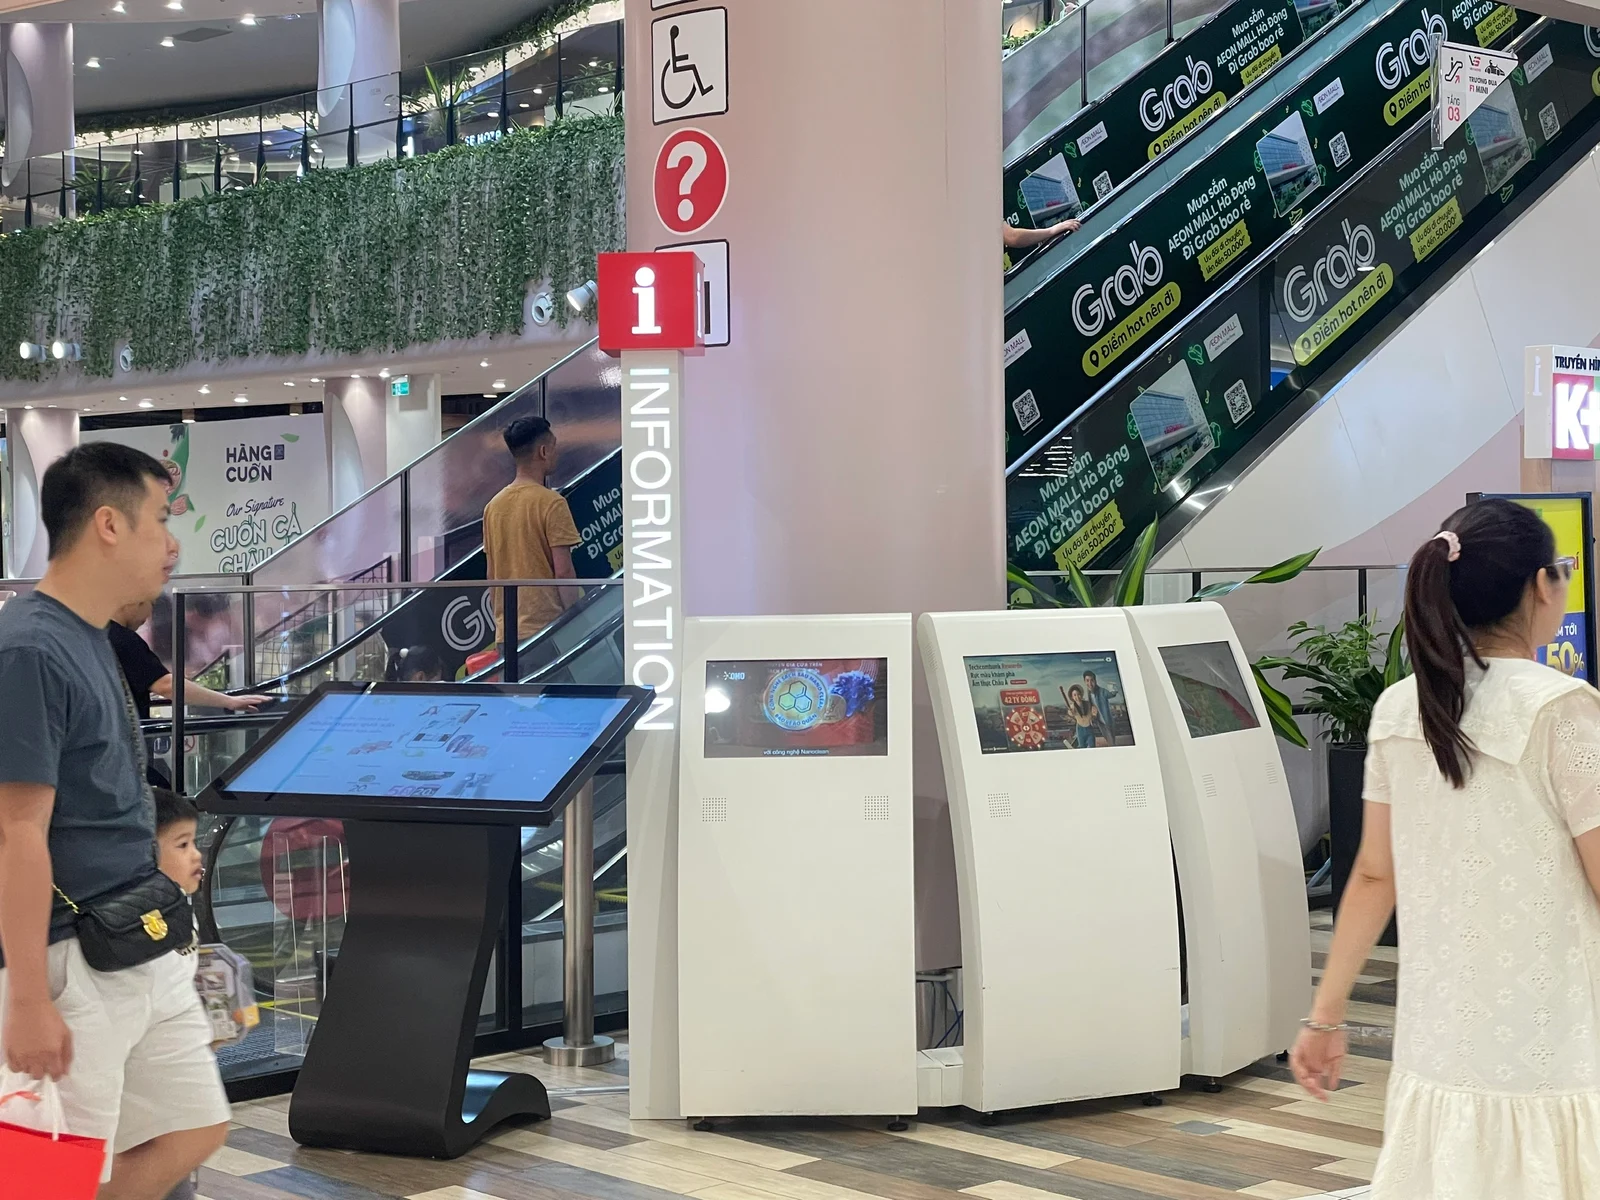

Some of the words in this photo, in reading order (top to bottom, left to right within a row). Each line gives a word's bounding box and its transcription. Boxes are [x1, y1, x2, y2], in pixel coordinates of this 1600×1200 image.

[1216, 43, 1238, 68] AEON
[1236, 30, 1258, 51] MALL
[1256, 21, 1268, 36] Hà
[1266, 7, 1288, 28] Đông
[1231, 20, 1249, 38] Mua
[1248, 8, 1265, 25] sắm
[1463, 13, 1473, 30] Đi
[1228, 59, 1239, 75] Đi
[1238, 45, 1259, 67] Grab
[1257, 34, 1274, 52] bao
[1376, 7, 1448, 89] Grab
[1139, 55, 1213, 132] Grab
[1398, 88, 1419, 111] Điểm
[1162, 130, 1184, 150] Điểm
[1183, 118, 1198, 134] hot
[1447, 106, 1460, 122] 03
[1380, 199, 1406, 232] AEON
[1404, 180, 1431, 209] MALL
[1429, 167, 1444, 187] Hà
[1442, 148, 1468, 175] Đông
[1399, 167, 1421, 192] Mua
[1420, 152, 1440, 174] sắm
[1168, 222, 1194, 253] AEON
[1192, 204, 1219, 232] MALL
[1217, 193, 1232, 212] Hà
[1230, 175, 1256, 200] Đông
[1186, 193, 1209, 216] Mua
[1208, 178, 1228, 199] sắm
[1394, 219, 1407, 240] Đi
[1406, 199, 1432, 229] Grab
[1430, 184, 1452, 206] bao
[1452, 169, 1463, 190] rẻ
[1182, 241, 1195, 260] Đi
[1194, 222, 1220, 250] Grab
[1218, 207, 1240, 230] bao
[1239, 194, 1252, 214] rẻ
[1071, 240, 1164, 337] Grab
[1283, 218, 1376, 323] Grab
[1101, 332, 1127, 359] Điểm
[1126, 316, 1146, 338] hot
[1145, 303, 1165, 323] nên
[1164, 289, 1175, 307] đi
[1313, 318, 1340, 347] Điểm
[1338, 300, 1358, 323] hot
[1358, 286, 1377, 307] nên
[1376, 271, 1387, 290] đi
[1010, 336, 1026, 351] MALL
[1221, 321, 1237, 338] MALL
[226, 443, 272, 464] HÀNG
[1039, 475, 1068, 502] Mua
[1067, 451, 1093, 479] sắm
[226, 503, 243, 518] Our
[244, 496, 285, 517] Signature
[592, 488, 620, 513] Mua
[1015, 512, 1049, 552] AEON
[1047, 486, 1081, 521] MALL
[1079, 470, 1099, 493] Hà
[1096, 444, 1130, 478] Đông
[1033, 534, 1051, 559] Đi
[1049, 509, 1083, 544] Grab
[1081, 487, 1109, 514] bao
[1109, 469, 1124, 493] rẻ
[586, 539, 603, 560] Đi
[629, 368, 675, 731] INFORMATION
[1062, 547, 1073, 560] Ưu
[1072, 536, 1084, 551] đãi
[1083, 530, 1090, 543] đi
[1089, 511, 1113, 536] chuyến
[1075, 549, 1089, 563] đến
[1564, 622, 1578, 636] TỚI
[1546, 641, 1585, 677] 50%
[1004, 696, 1013, 704] 42
